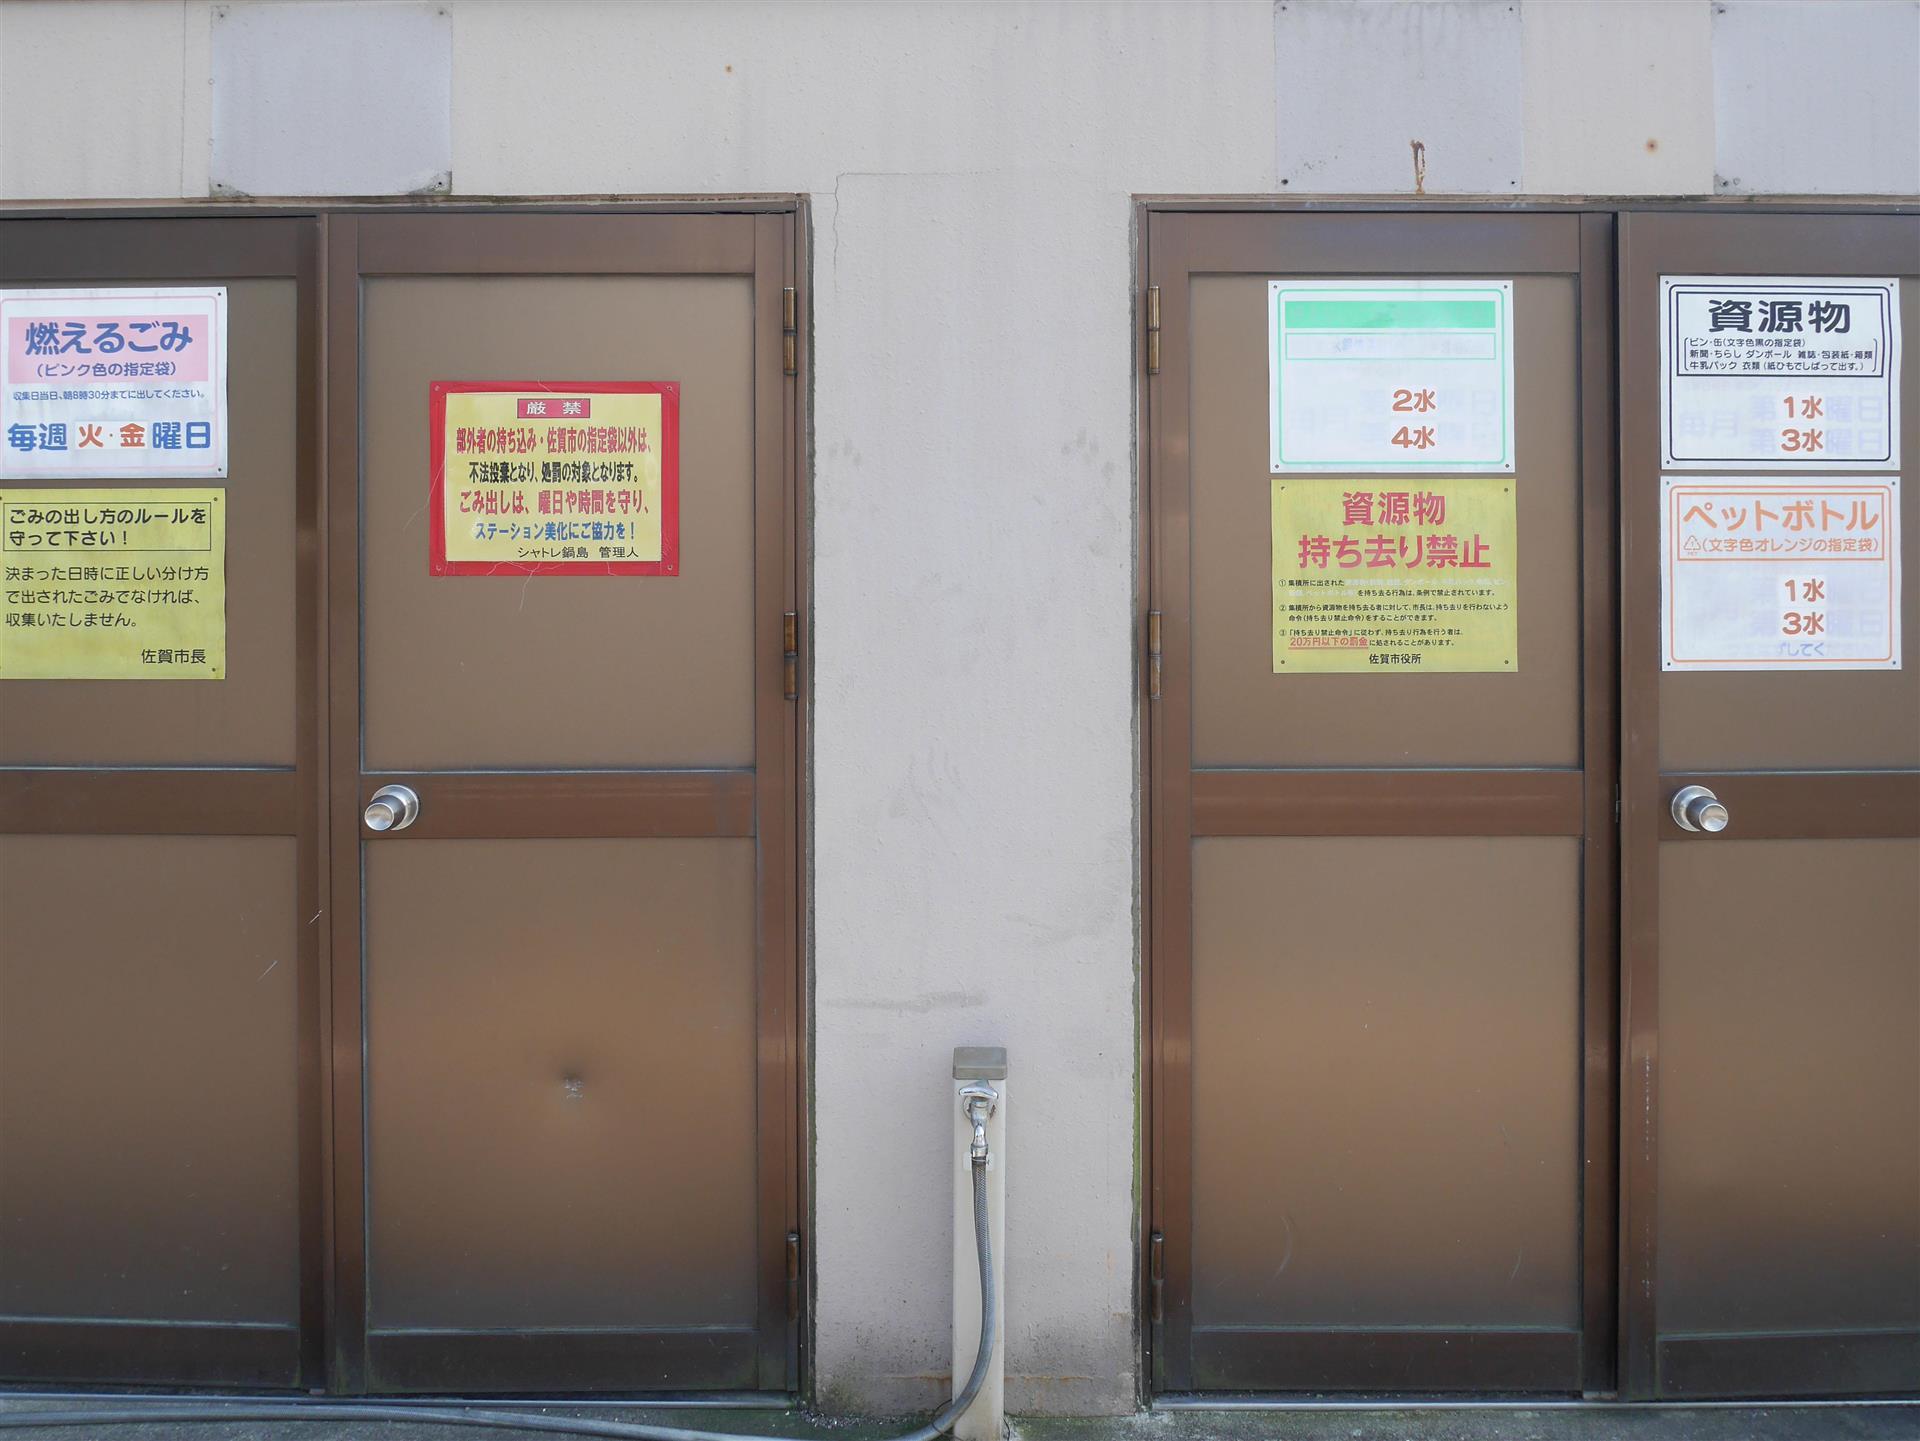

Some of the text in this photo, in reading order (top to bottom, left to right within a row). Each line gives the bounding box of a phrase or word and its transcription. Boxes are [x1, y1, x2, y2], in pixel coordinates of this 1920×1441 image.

[1708, 299, 1850, 334] 資源物
[25, 320, 193, 355] 燃えるごみ
[37, 360, 177, 378] (ピンク色の指定袋)
[13, 389, 204, 400] 収集日当日、朝8時30分までに出してください。
[1392, 389, 1436, 413] 2水
[1783, 395, 1824, 420] 1水
[8, 421, 211, 451] 毎週火・金曜日
[456, 427, 652, 454] 部外者の持ち込み・佐賀市の指定袋以外は、
[1391, 426, 1436, 450] 4水
[1781, 428, 1824, 452] 3水
[469, 461, 639, 483] 不法投棄となり、処罰の対象となります。
[460, 490, 650, 515] ごみ出しは、曜日や時間を守り、
[1342, 491, 1447, 526] 資源物
[10, 508, 207, 525] ごみの出し方のルールを
[1682, 500, 1880, 532] ペットボトル
[9, 530, 128, 547] 守って下さい!
[475, 522, 636, 541] ステーション美化にご協力を!
[518, 546, 640, 559] シャトレ鍋島 管理人
[1298, 534, 1491, 569] 持ち去り禁止
[1702, 538, 1879, 553] (文字色オレンジの指定袋)
[5, 566, 209, 582] 決まった日時に正しい分け方
[6, 589, 200, 604] で出されたごみでなければ、
[1784, 578, 1826, 602] 1水
[6, 613, 137, 628] 収集いたしません。
[1781, 611, 1825, 635] 3水
[141, 648, 207, 664] 佐賀市長
[1368, 653, 1422, 665] 佐賀市役所
